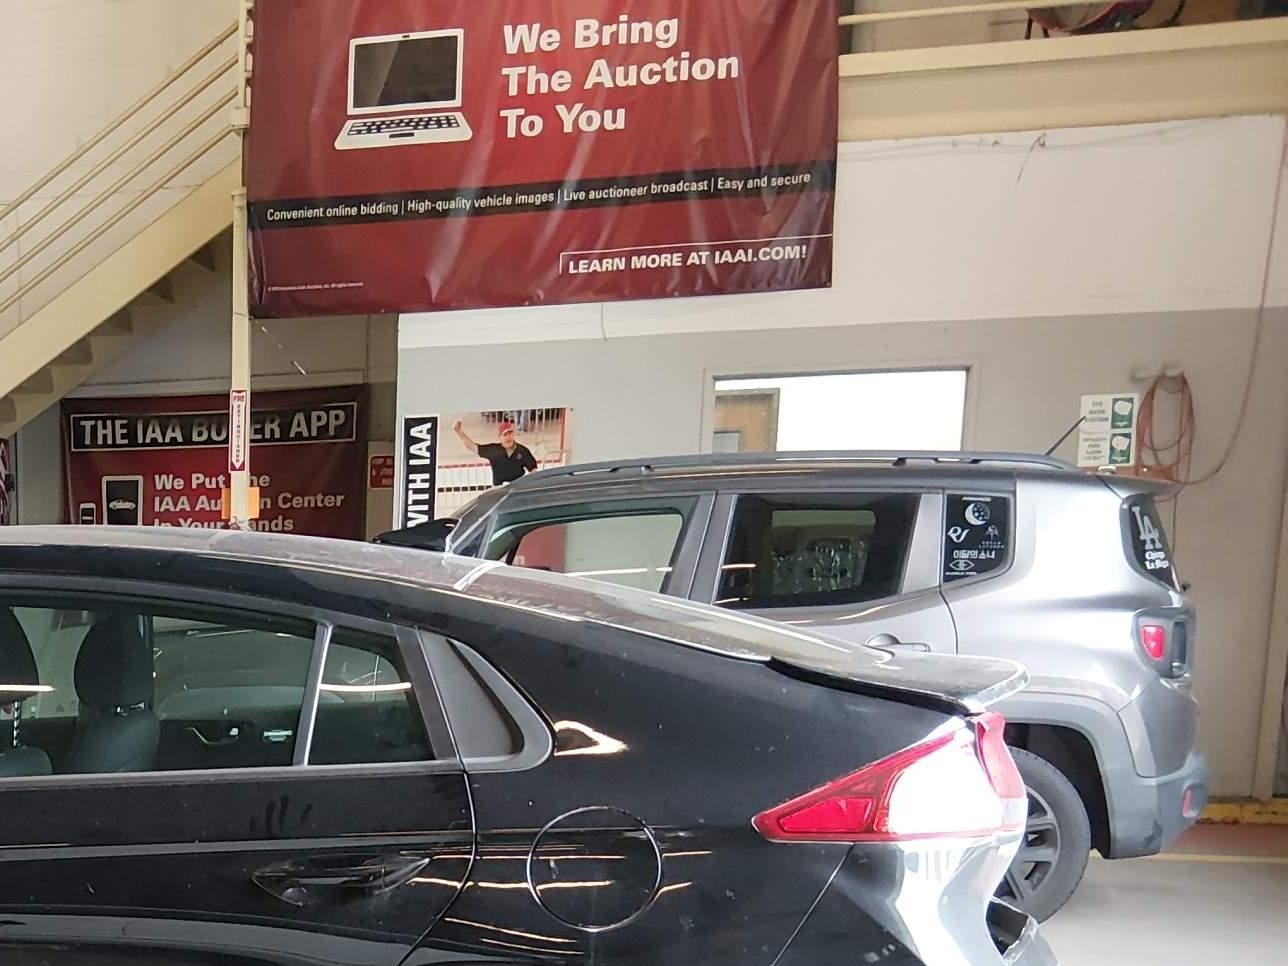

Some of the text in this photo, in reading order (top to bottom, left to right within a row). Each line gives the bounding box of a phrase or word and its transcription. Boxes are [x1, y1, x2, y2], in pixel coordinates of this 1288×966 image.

[503, 14, 679, 55] We Bring
[501, 51, 739, 97] The Auction
[499, 102, 626, 138] To You
[267, 206, 324, 221] Convenient
[326, 204, 358, 218] online
[360, 202, 399, 216] bidding
[407, 197, 472, 213] High-quality
[474, 195, 513, 208] vehicle
[515, 191, 555, 205] images
[564, 190, 586, 202] Live
[589, 186, 648, 200] auctioneer
[650, 179, 708, 195] broadcast
[717, 177, 744, 192] Easy
[747, 175, 768, 189] and
[771, 173, 811, 187] secure
[569, 245, 807, 274] LEARN MORE AT IAAI.COM!
[79, 410, 346, 445] THE IAA BUER APP
[409, 422, 433, 466] IAA
[154, 474, 185, 490] We
[191, 473, 226, 490] Put
[154, 496, 190, 512] IAA
[277, 492, 344, 509] Center
[249, 515, 294, 532] ands
